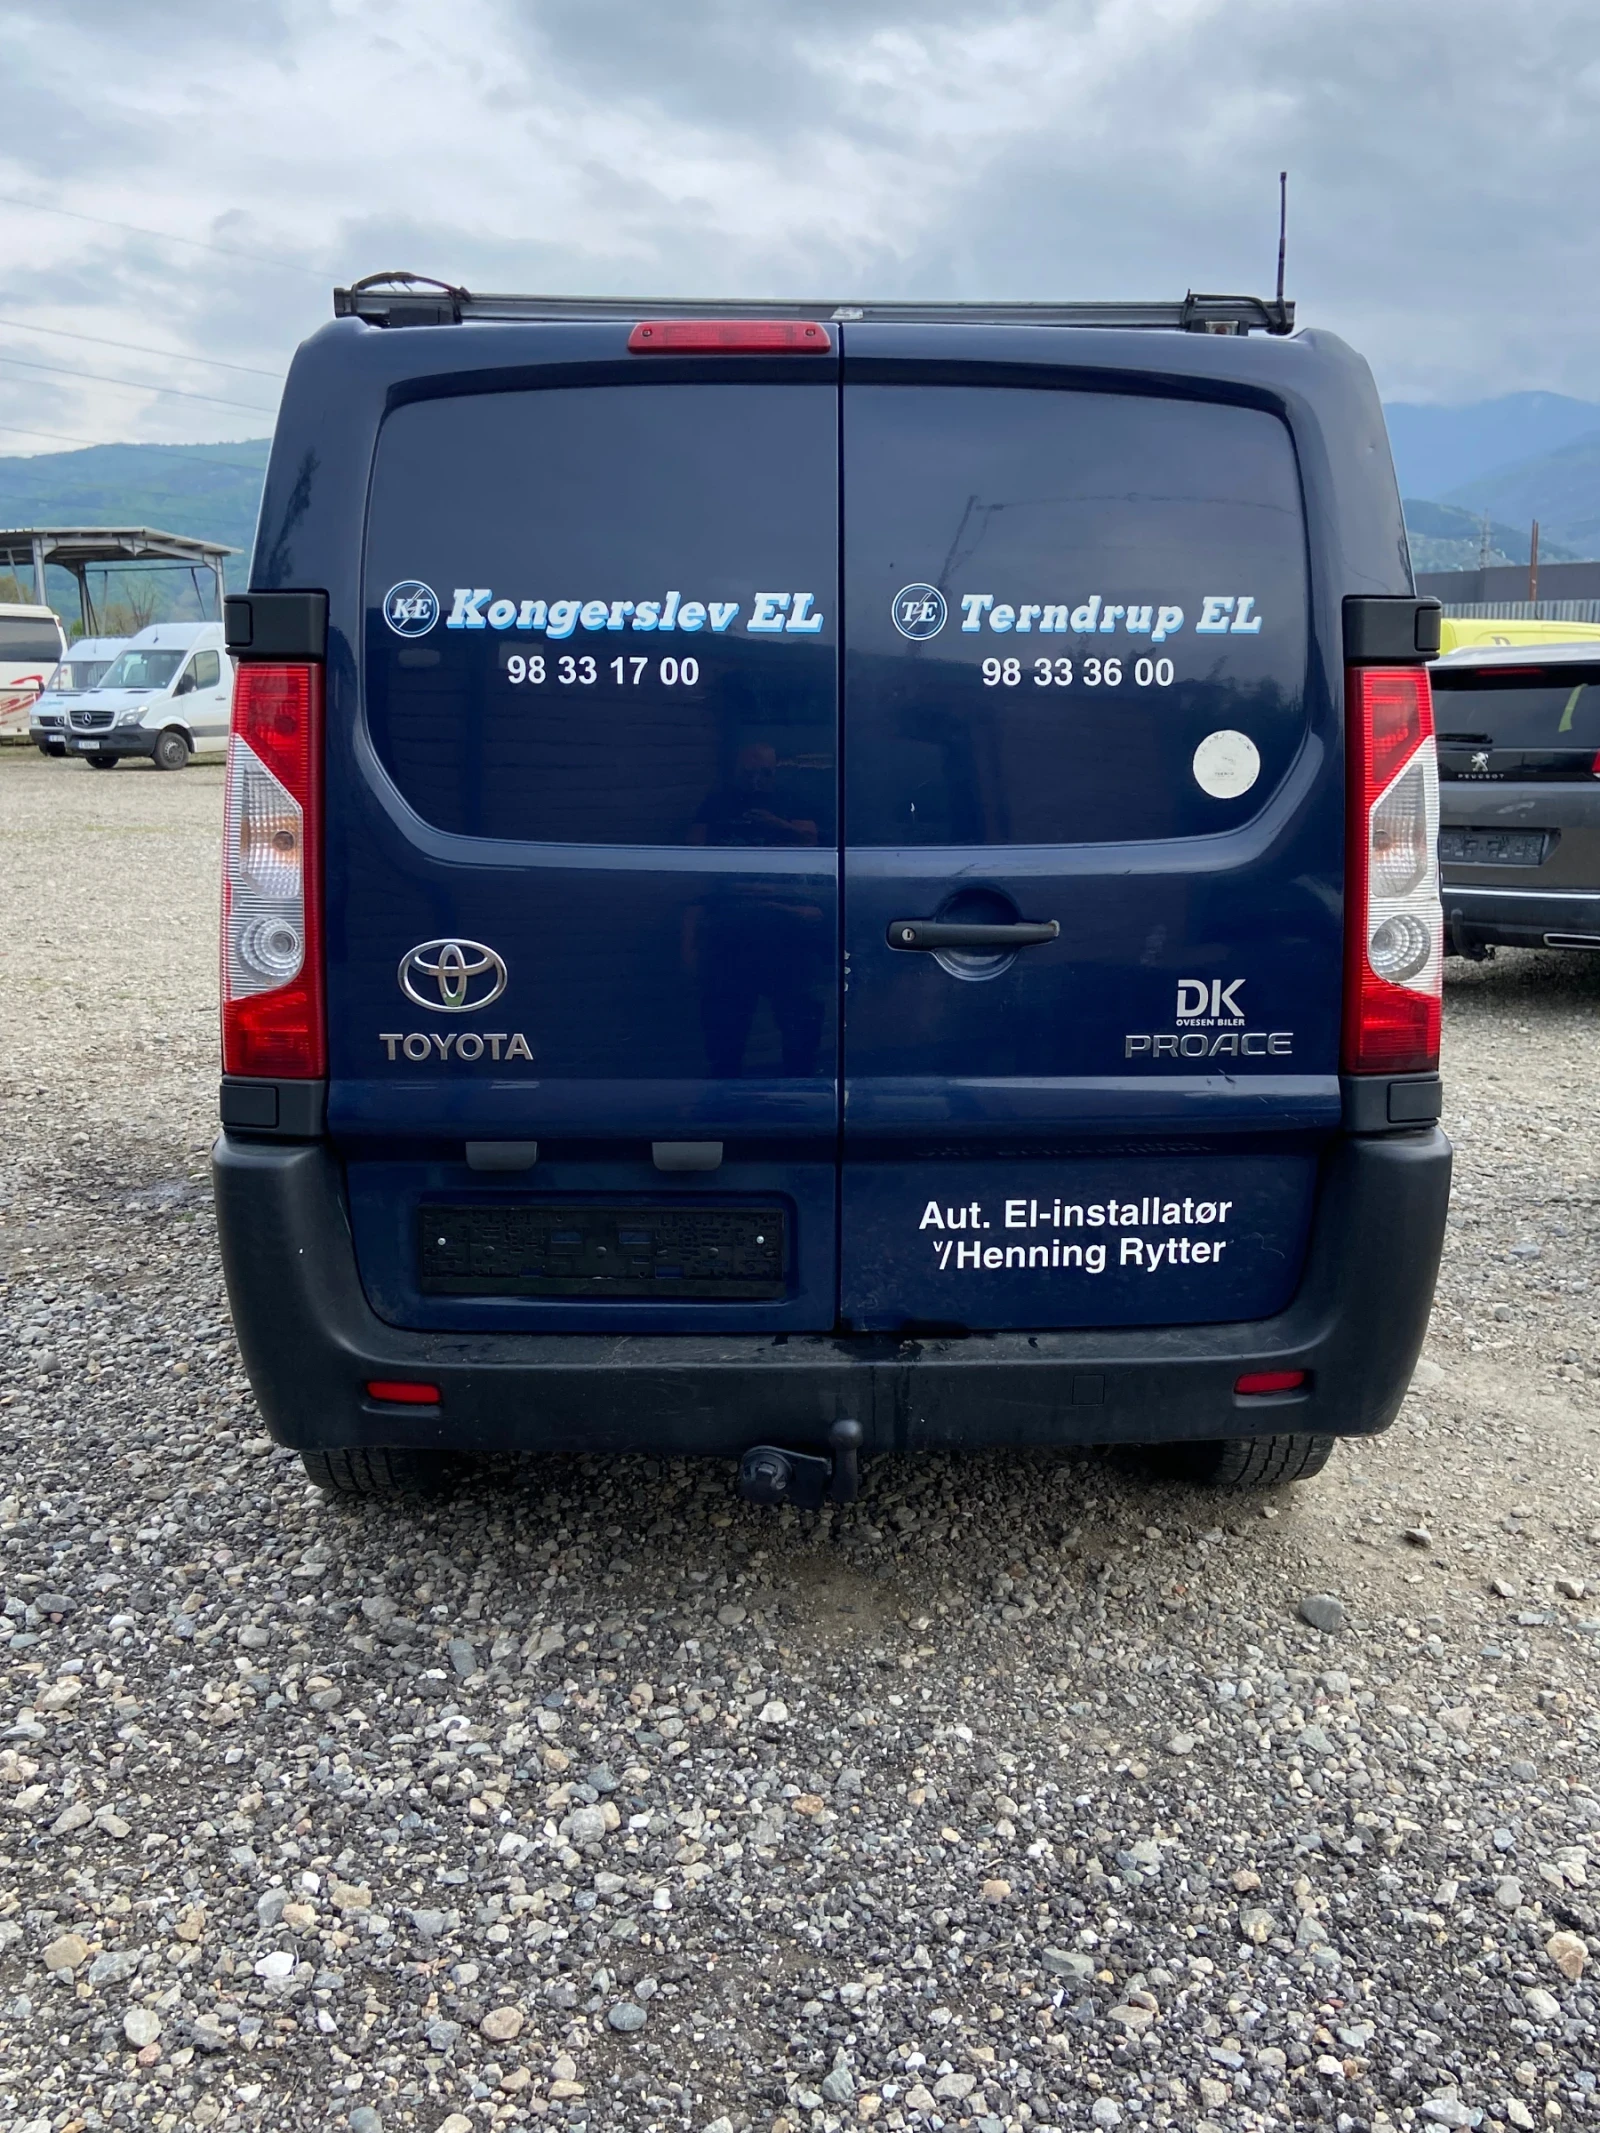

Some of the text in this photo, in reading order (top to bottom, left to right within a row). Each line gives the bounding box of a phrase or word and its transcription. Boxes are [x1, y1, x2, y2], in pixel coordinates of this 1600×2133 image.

[446, 588, 824, 639] Kongerslev EL
[960, 594, 1262, 642] Terndrup EL
[507, 655, 699, 685] 98 33 17 00
[981, 657, 1174, 686] 98 33 36 00
[1176, 979, 1246, 1017] DK
[1175, 1018, 1246, 1026] OVESEN BILER
[379, 1033, 534, 1061] TOYOTA
[1125, 1032, 1294, 1059] PROACE
[919, 1197, 1233, 1230] Aut. El-installatør
[1119, 1237, 1227, 1273] Rytter
